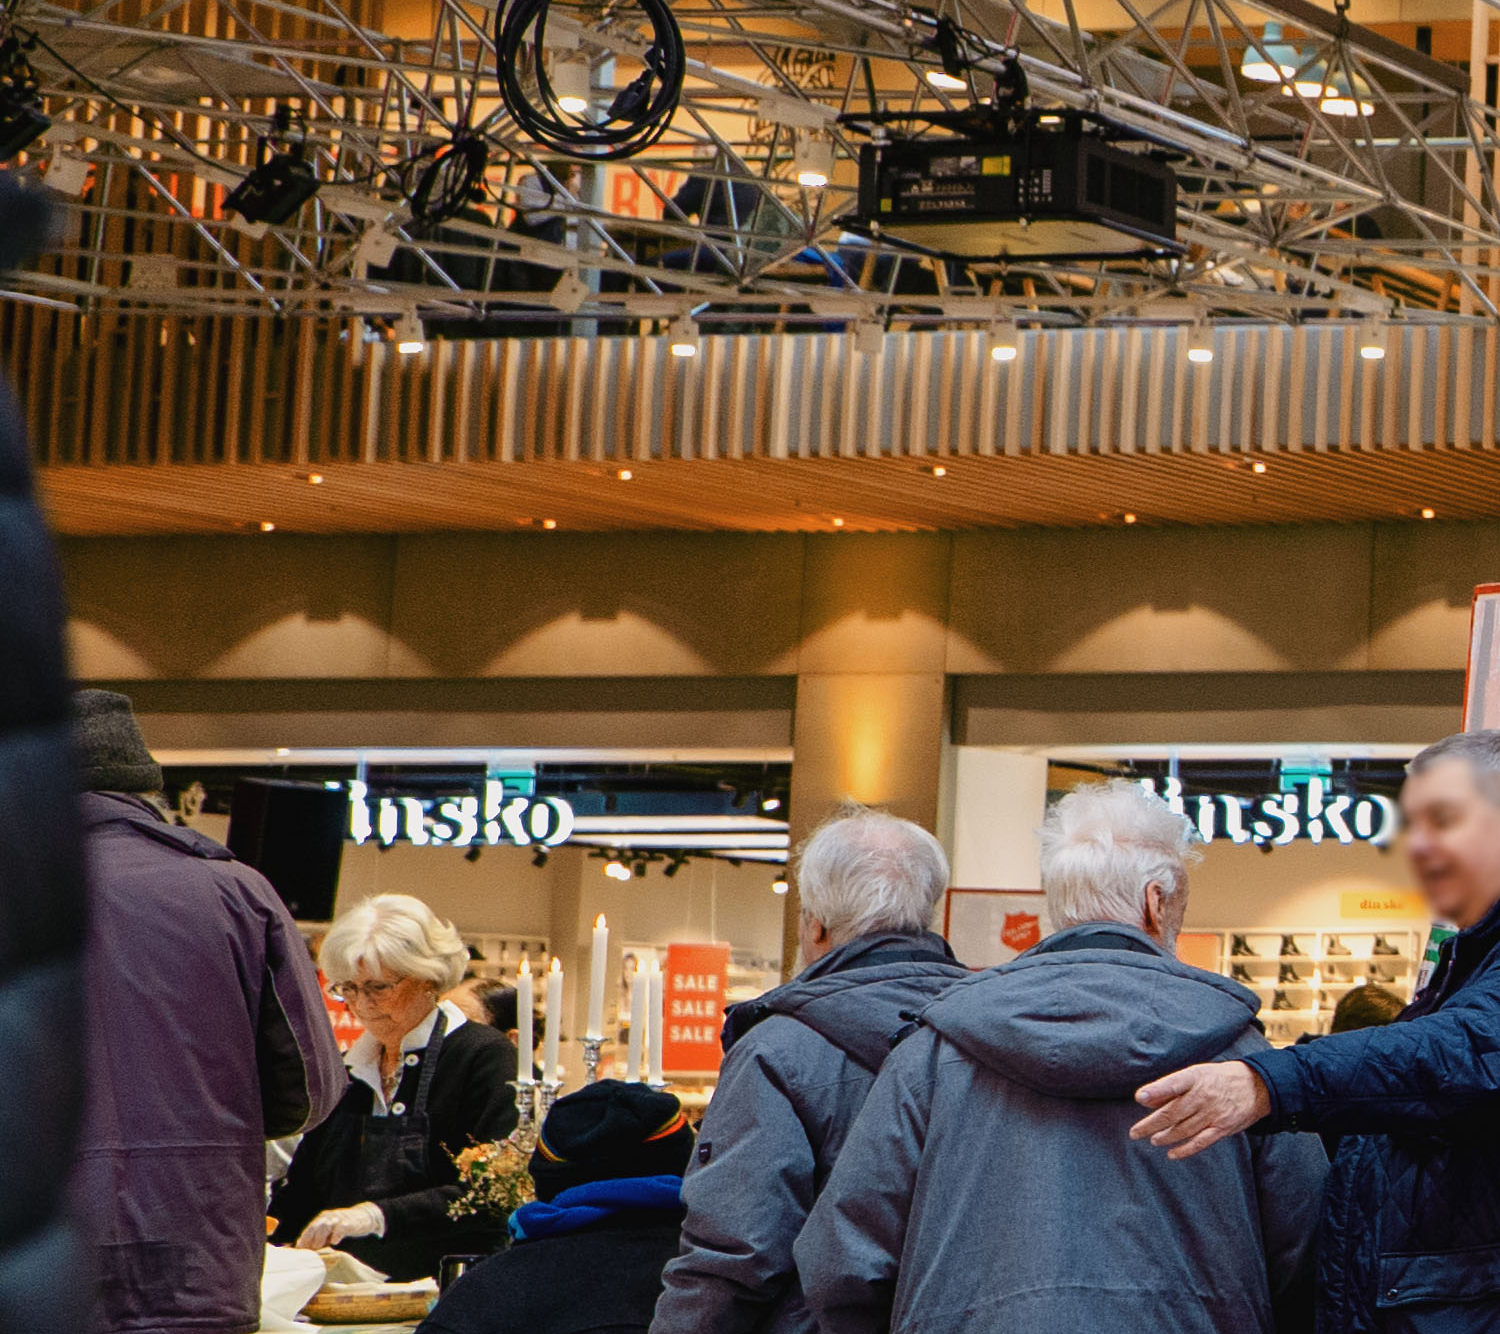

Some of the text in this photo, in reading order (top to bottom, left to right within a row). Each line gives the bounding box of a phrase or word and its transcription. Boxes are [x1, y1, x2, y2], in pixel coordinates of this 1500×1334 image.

[347, 779, 577, 847] insko
[1140, 777, 1400, 846] insko
[673, 974, 718, 993] SALE
[671, 1000, 716, 1018] SALE
[669, 1025, 714, 1044] SALE
